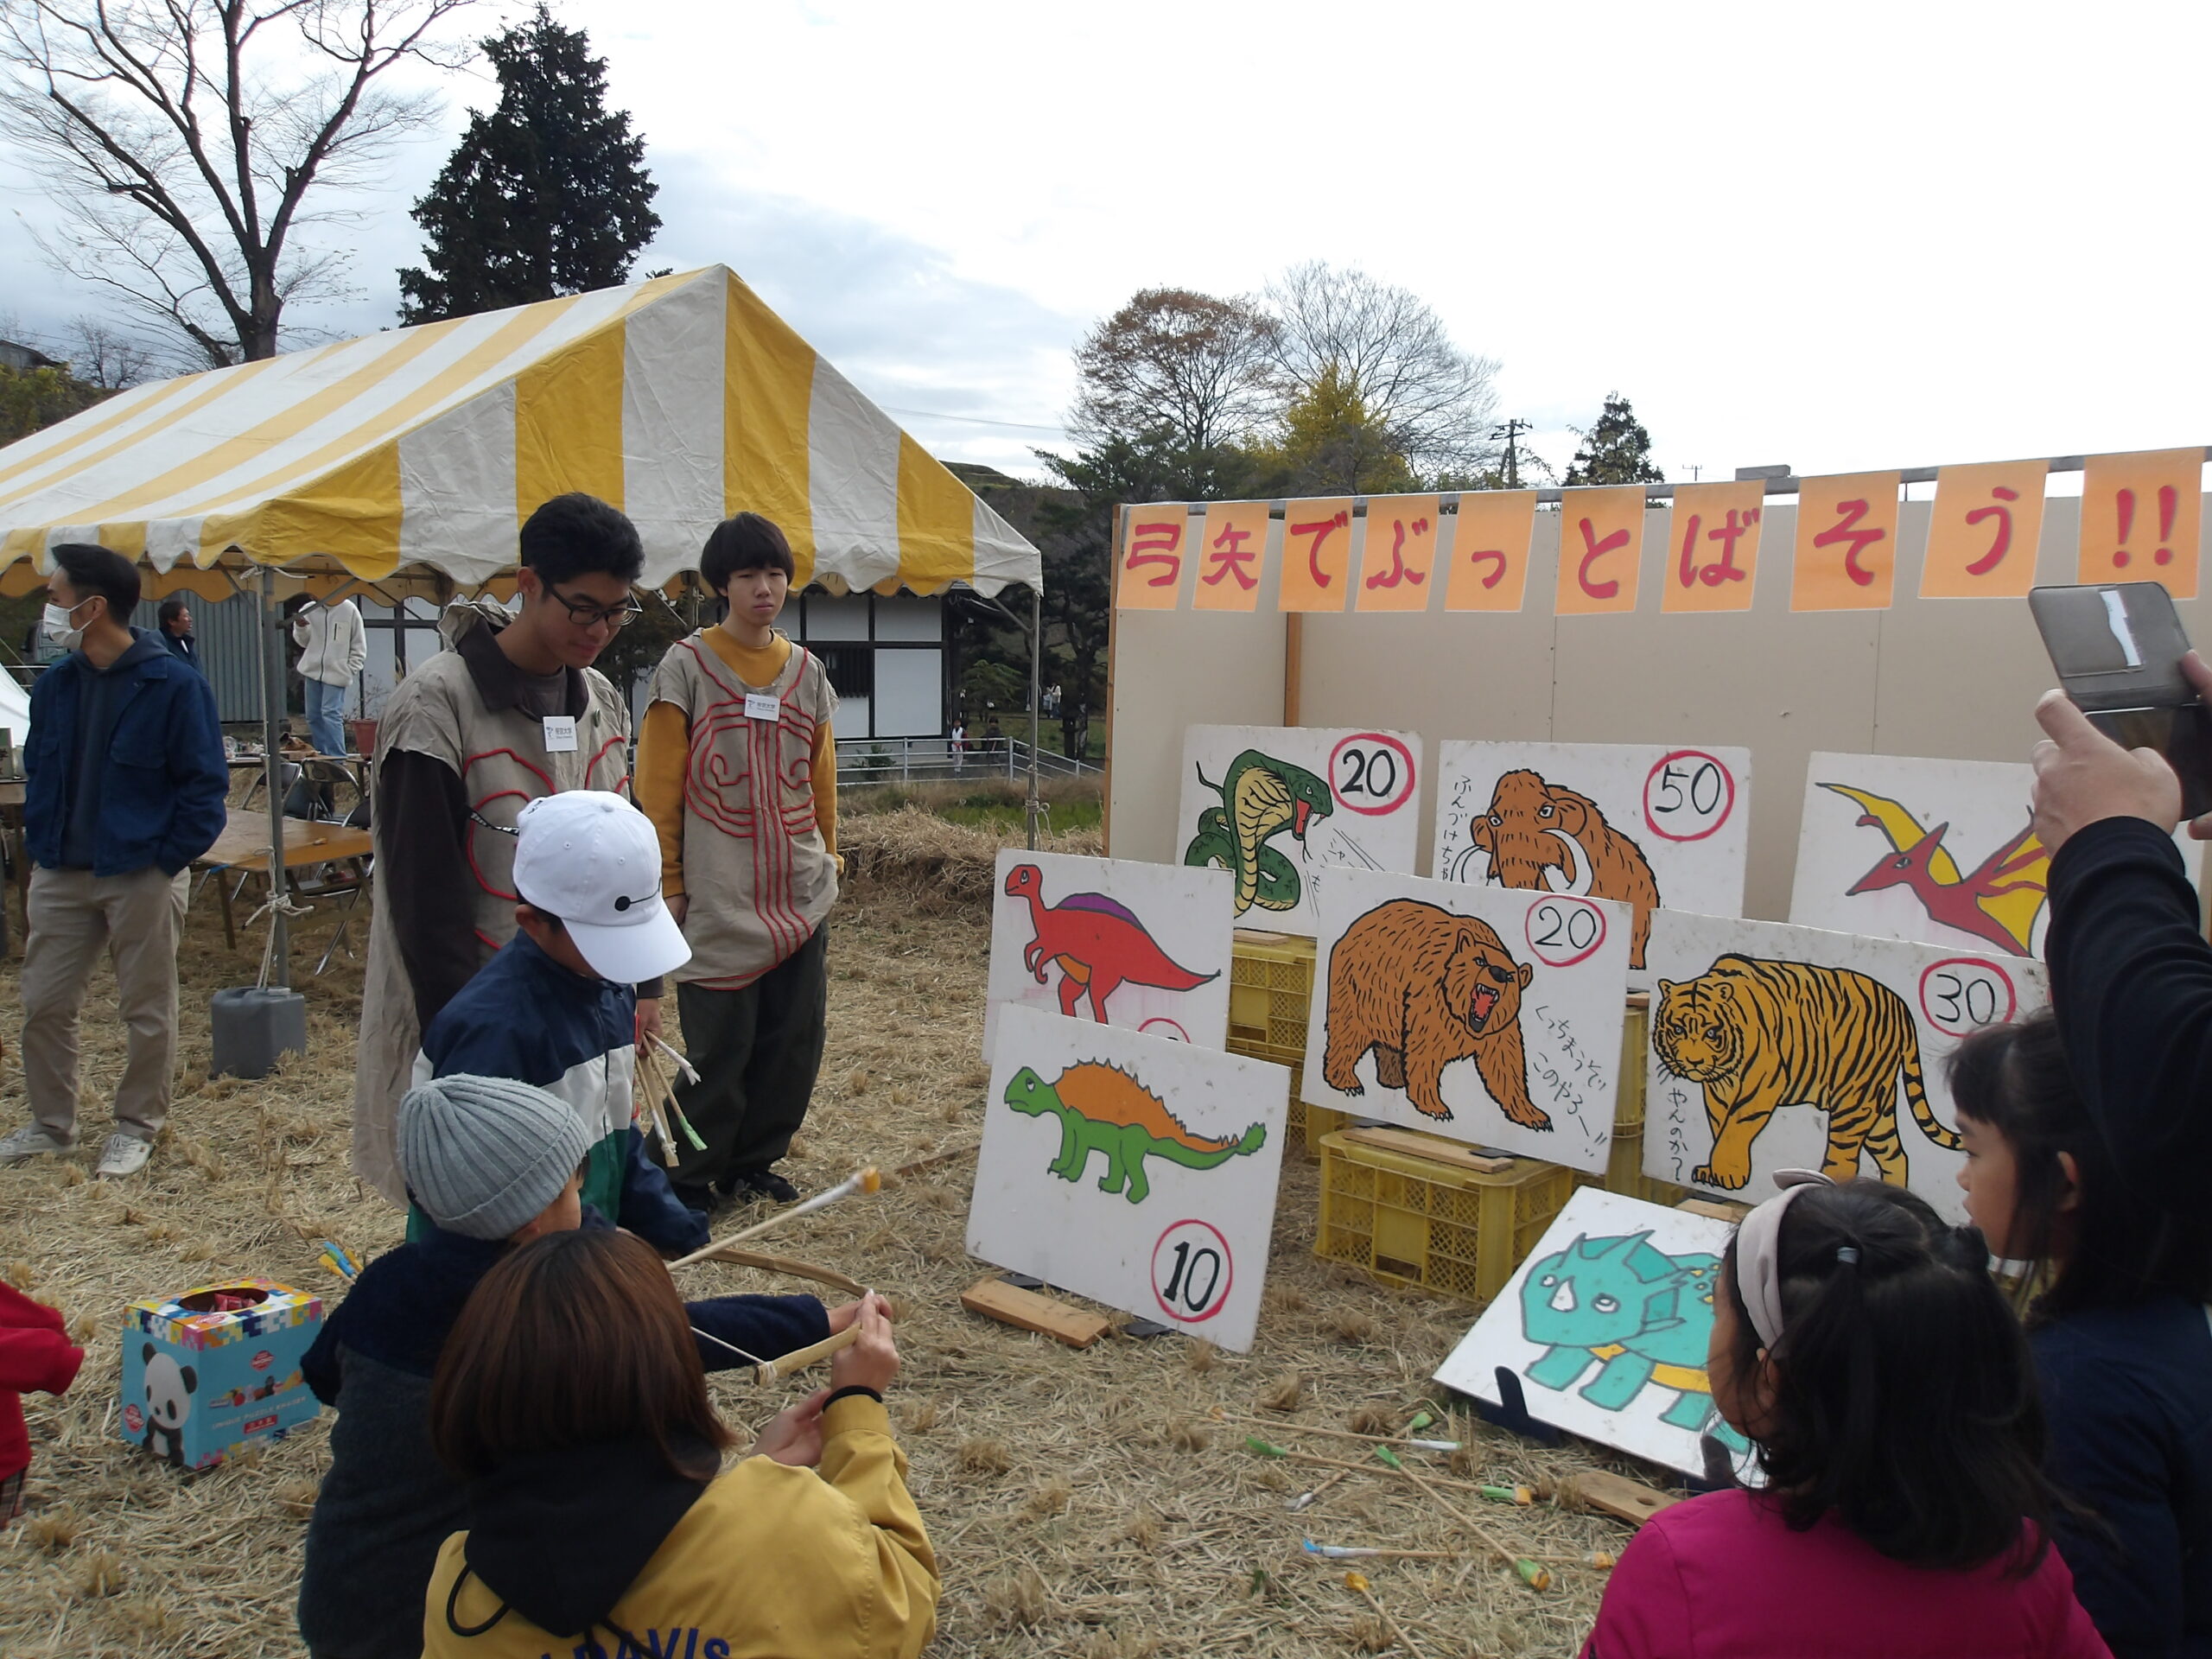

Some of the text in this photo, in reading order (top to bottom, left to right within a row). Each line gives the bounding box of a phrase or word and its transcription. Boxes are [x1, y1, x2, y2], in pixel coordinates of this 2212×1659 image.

[1126, 485, 2178, 599] 弓矢でぶっとばそう!!
[1339, 748, 1396, 798] 20
[1654, 762, 1722, 815] 50
[1534, 905, 1597, 950] 20
[1935, 973, 1996, 1025] 30
[1162, 1241, 1220, 1313] 10
